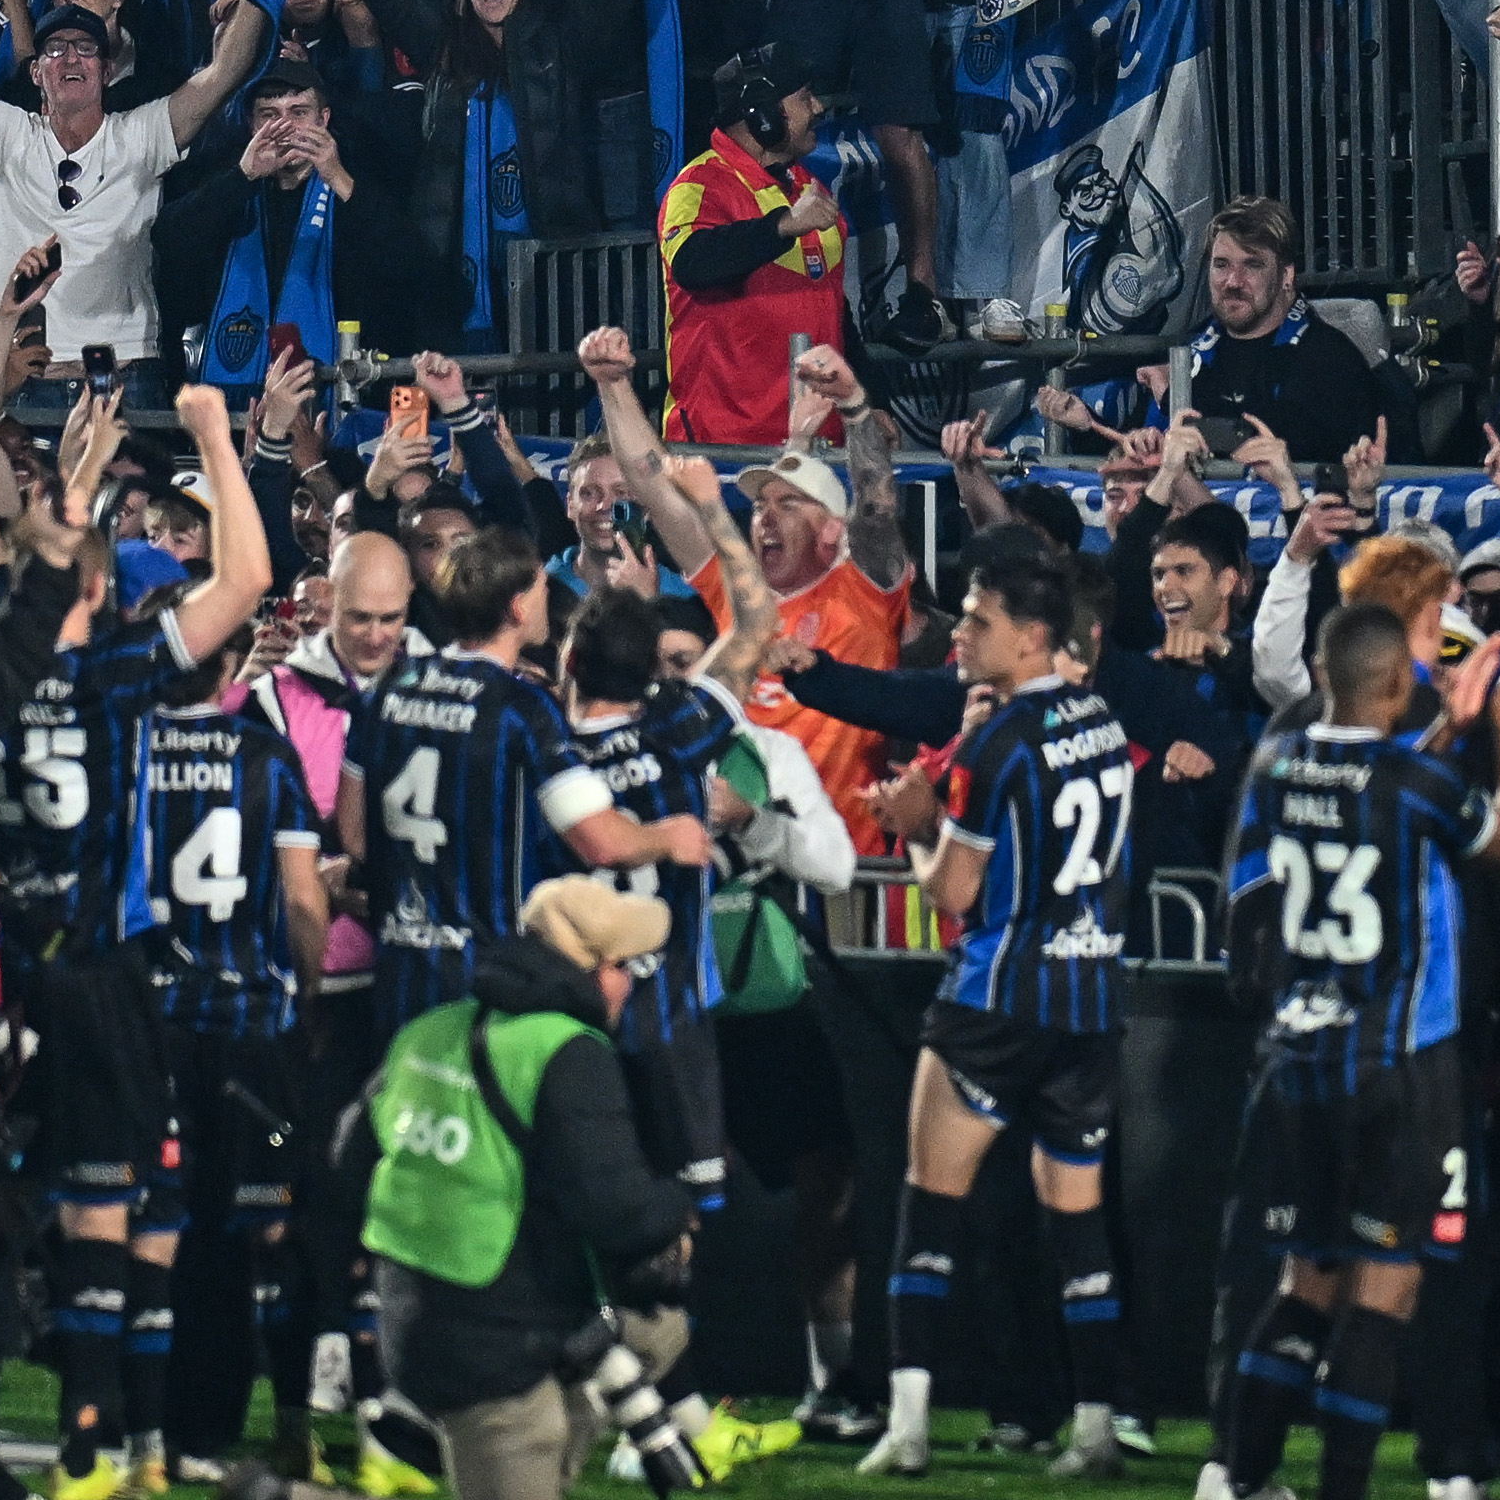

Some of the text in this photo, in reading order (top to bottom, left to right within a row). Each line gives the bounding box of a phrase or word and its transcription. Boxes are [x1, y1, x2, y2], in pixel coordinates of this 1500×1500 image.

[151, 729, 243, 758] Liberty
[151, 760, 235, 791] ILLION
[380, 745, 449, 866] 4
[1052, 762, 1137, 897] 27
[1267, 834, 1384, 965] 23
